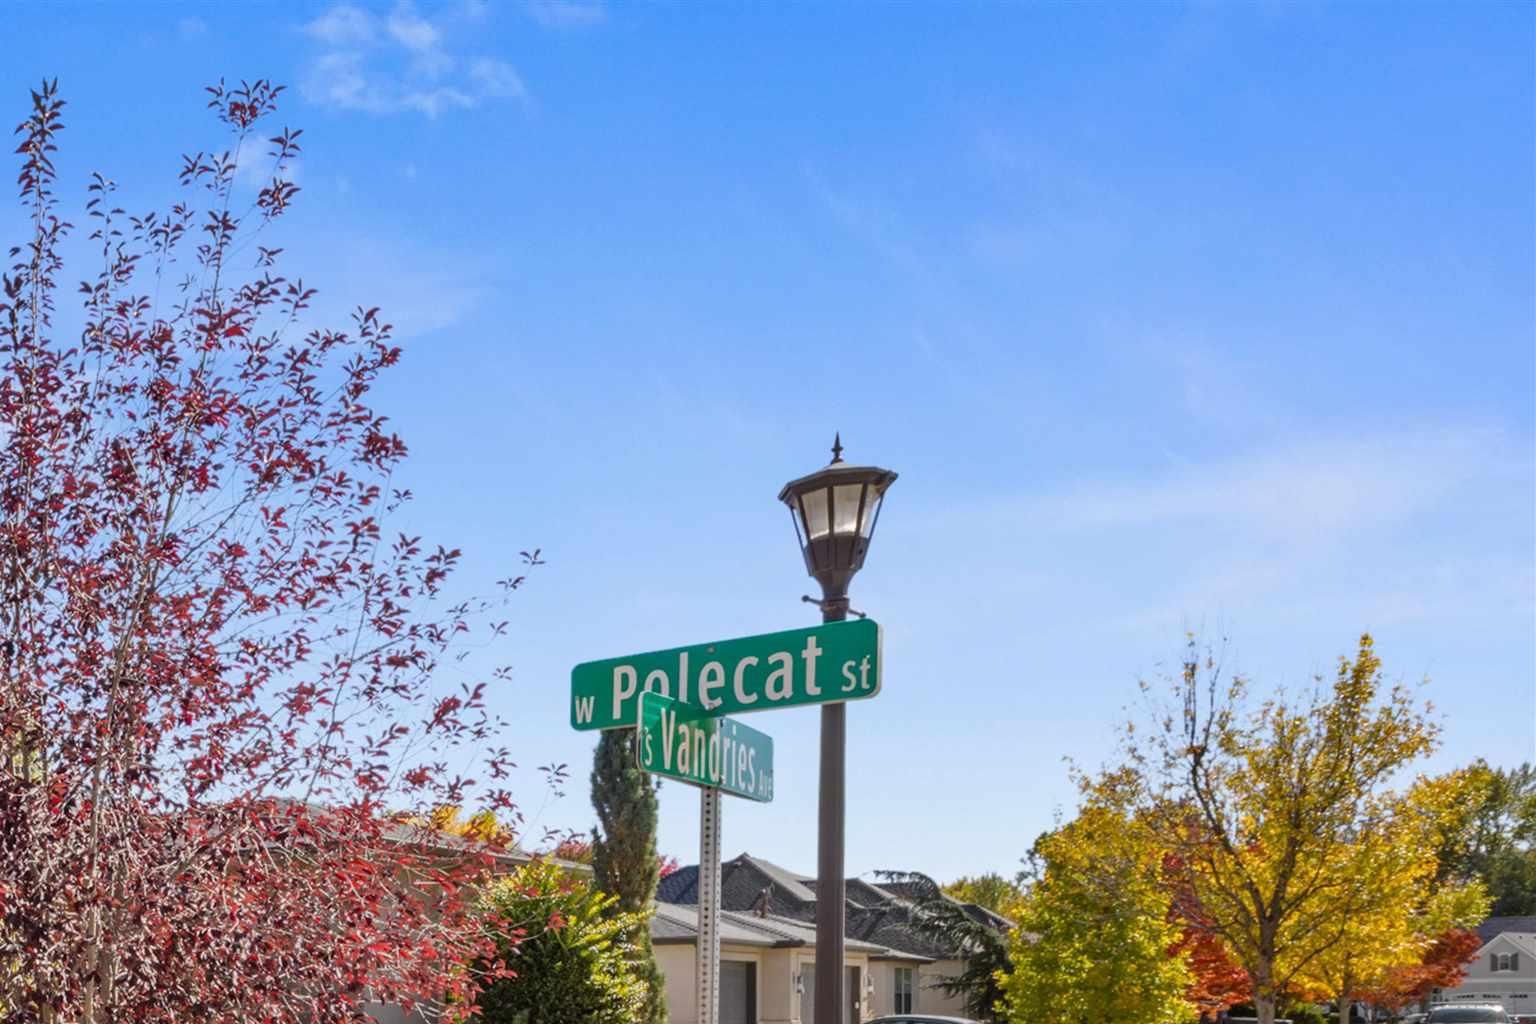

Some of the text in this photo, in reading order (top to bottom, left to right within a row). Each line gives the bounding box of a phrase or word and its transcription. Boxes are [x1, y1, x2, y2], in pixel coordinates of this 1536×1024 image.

[574, 635, 871, 724] W Polecat St
[644, 733, 653, 767] S
[660, 706, 756, 793] Vandries
